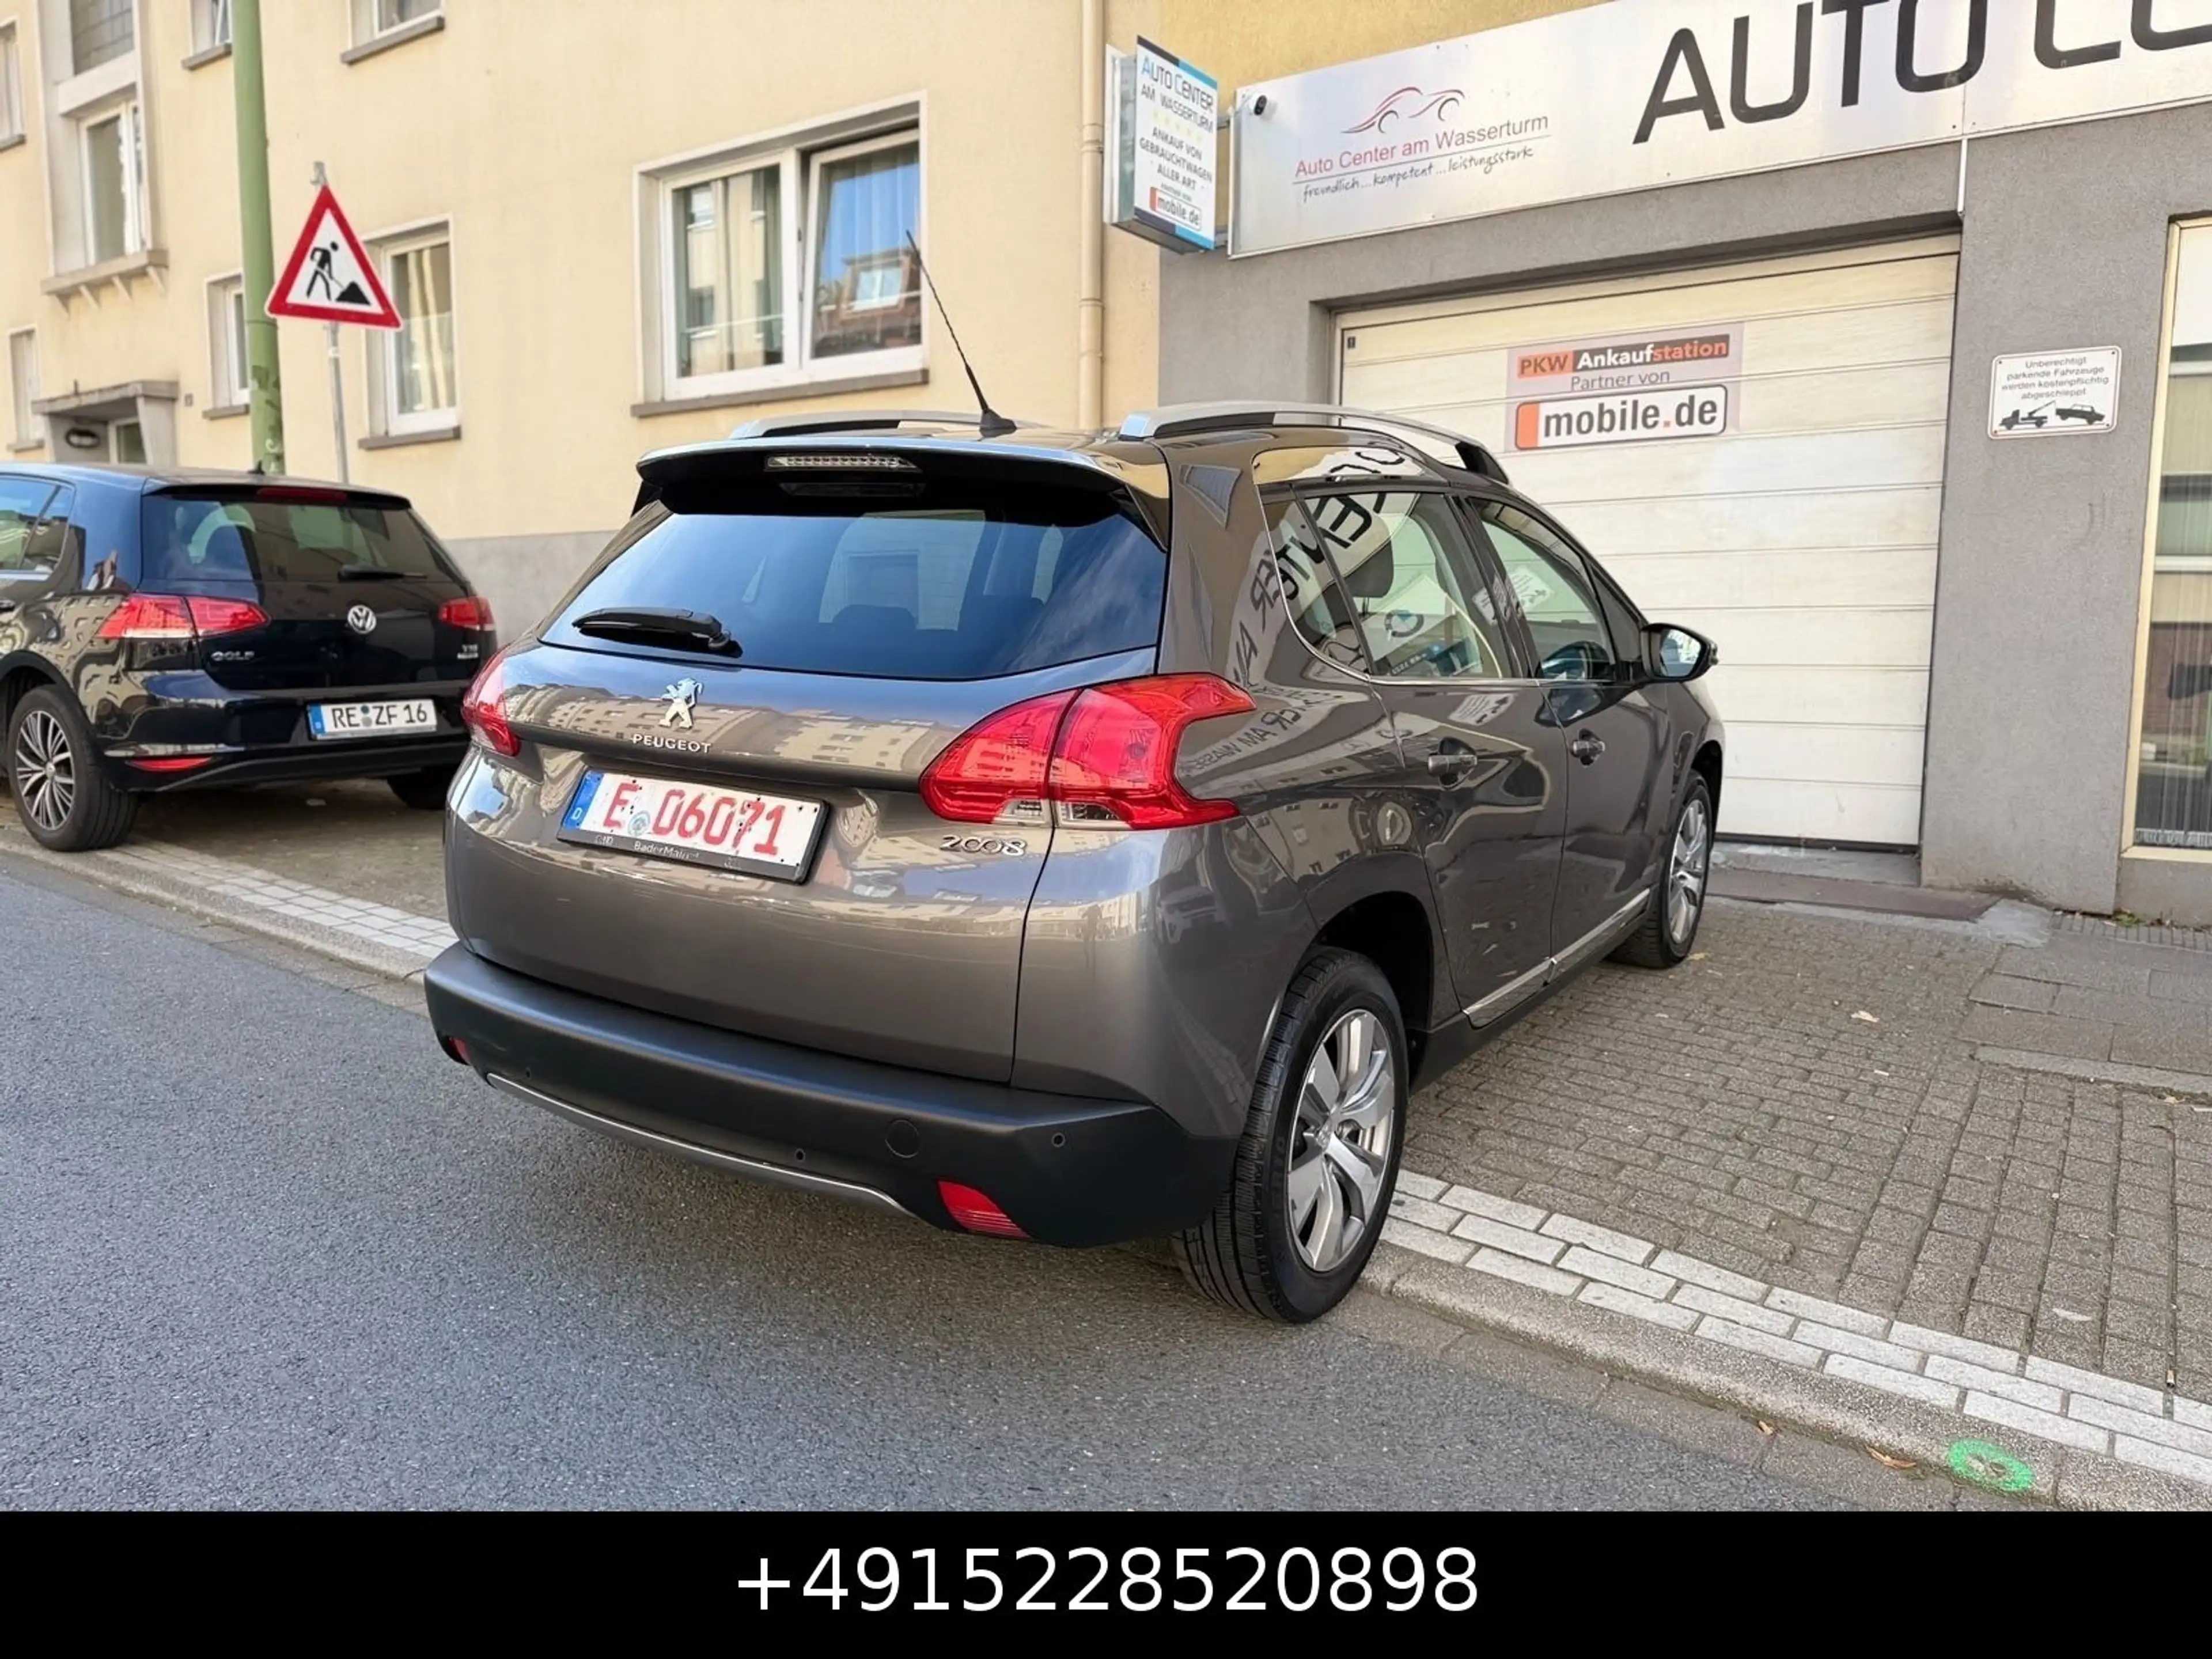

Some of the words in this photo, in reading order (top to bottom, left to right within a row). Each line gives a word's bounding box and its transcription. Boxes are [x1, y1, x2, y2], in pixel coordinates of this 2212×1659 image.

[1142, 55, 1172, 90] AUTO
[1175, 73, 1213, 114] CENTER
[1632, 0, 1987, 144] AUTO
[1141, 84, 1155, 102] AM
[1160, 93, 1213, 134] WASSERTURM
[1152, 126, 1184, 150] ANKAUF
[1185, 144, 1202, 161] VON
[1295, 159, 1334, 178] Auto
[1339, 144, 1397, 169] Center
[1401, 139, 1430, 157] am
[1435, 115, 1548, 150] Wasserturm
[1139, 137, 1213, 183] GEBRAUCHTWAGEN
[1157, 163, 1180, 183] ALLER
[1181, 175, 1197, 191] ART
[1520, 354, 1569, 376] PKW
[2006, 370, 2051, 382] parkende
[2054, 365, 2105, 377] Fahrzeuge
[2025, 356, 2087, 369] Unberechtigt
[1570, 374, 1633, 392] Partner
[1638, 369, 1671, 385] von
[2001, 381, 2036, 391] werden
[2037, 376, 2109, 389] kostenpflichtig
[2021, 387, 2086, 400] abgeschleppt
[1543, 394, 1718, 438] mobile.de
[210, 650, 255, 662] GOLF
[332, 706, 363, 729] RE
[374, 704, 399, 726] ZF
[404, 703, 427, 724] 16
[632, 733, 712, 755] PEUGEOT
[603, 782, 641, 830] E
[651, 789, 787, 857] 06071
[940, 834, 1028, 857] 2008
